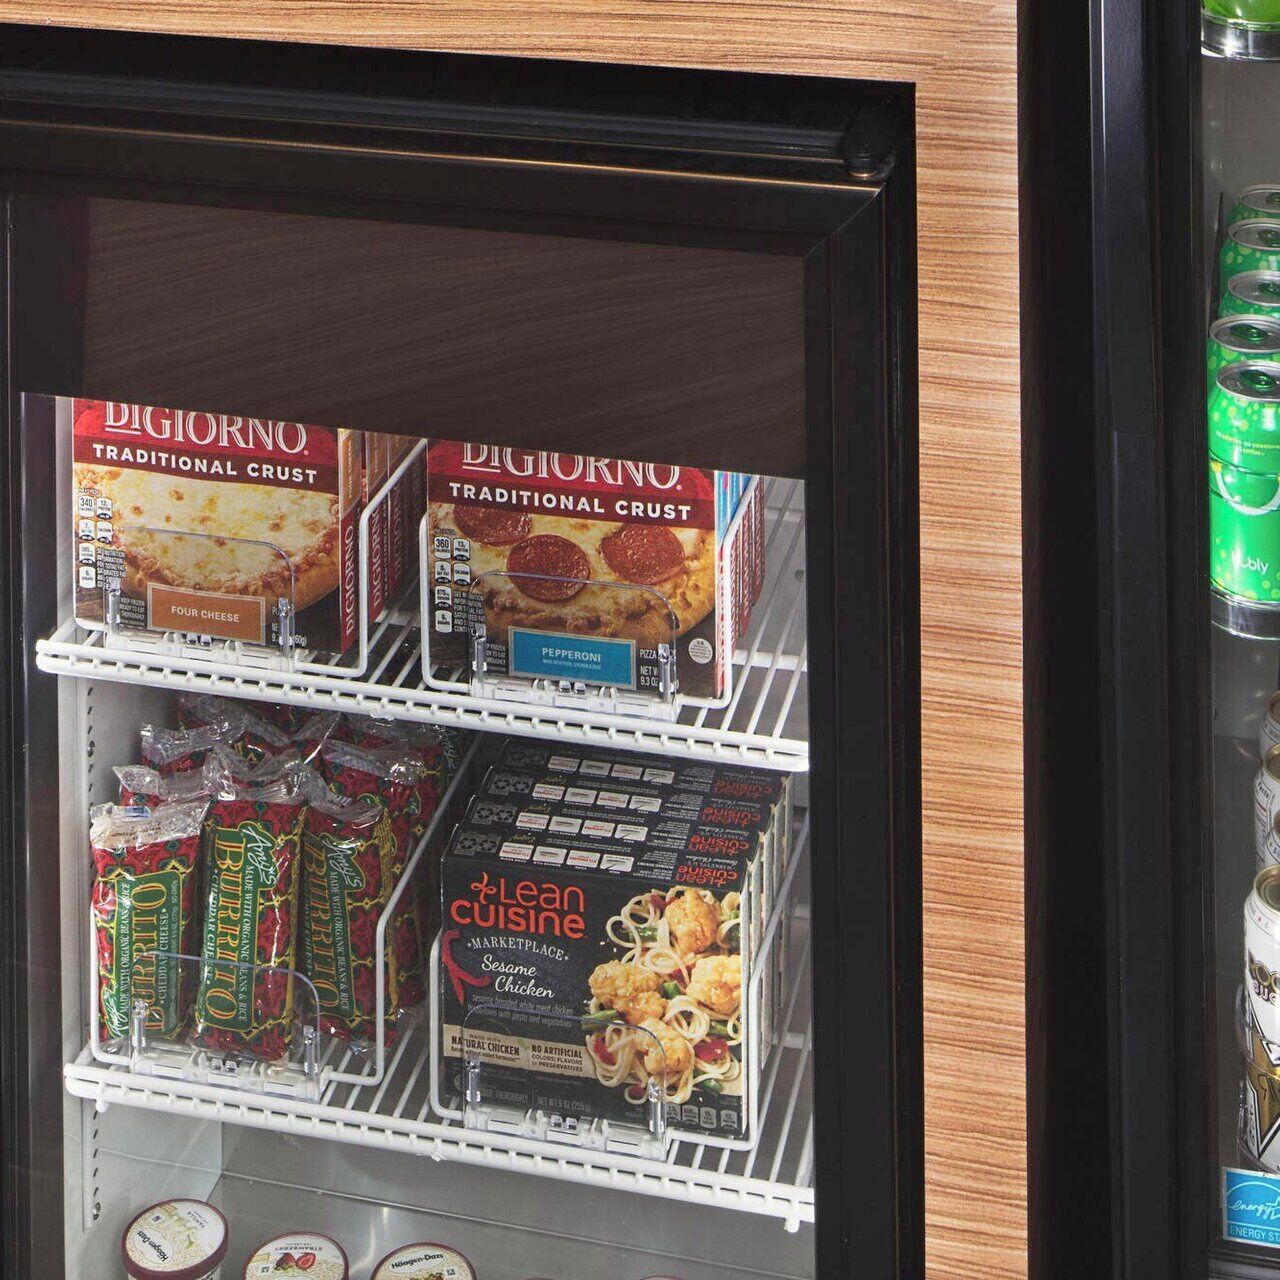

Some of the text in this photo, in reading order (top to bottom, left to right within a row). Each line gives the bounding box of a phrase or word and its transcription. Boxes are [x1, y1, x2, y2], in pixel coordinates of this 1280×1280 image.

[92, 443, 318, 484] TRADITIONAL CRUST
[448, 482, 692, 521] TRADITIONAL CRUST
[171, 606, 240, 623] FOUR CHEESE
[541, 647, 603, 663] PEPPERONI
[244, 826, 278, 886] Amy's
[206, 841, 244, 1020] BURRITO
[473, 936, 565, 961] MARKETPLACE
[481, 953, 538, 978] Sesame
[494, 974, 555, 999] Chicken
[451, 1035, 520, 1055] NATURAL CHICKEN
[531, 1043, 583, 1059] NO ARTIFICIAL
[537, 1061, 583, 1072] PRESERVATIVES
[1230, 1226, 1266, 1240] ENERGY
